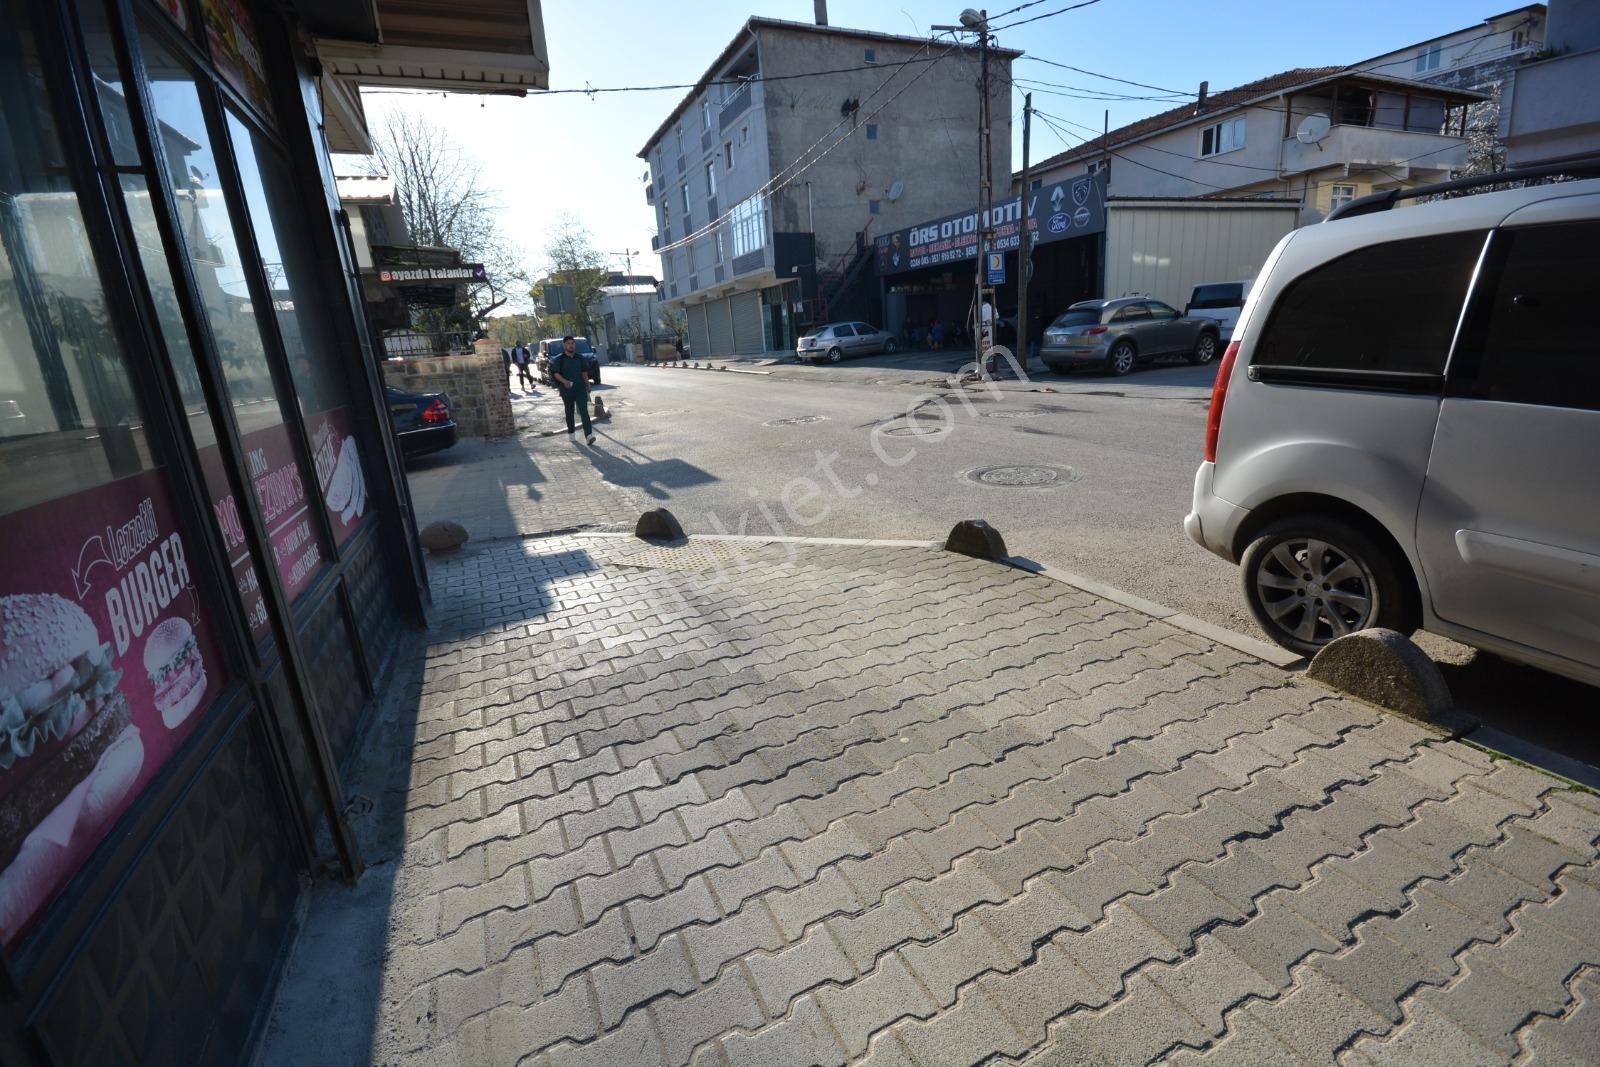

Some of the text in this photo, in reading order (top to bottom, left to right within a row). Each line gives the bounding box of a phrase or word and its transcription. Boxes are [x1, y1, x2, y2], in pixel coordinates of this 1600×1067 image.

[1051, 217, 1069, 231] Ford
[910, 226, 938, 246] ÖRS
[392, 267, 473, 281] ayazda kalanlar
[105, 531, 190, 657] BURGER
